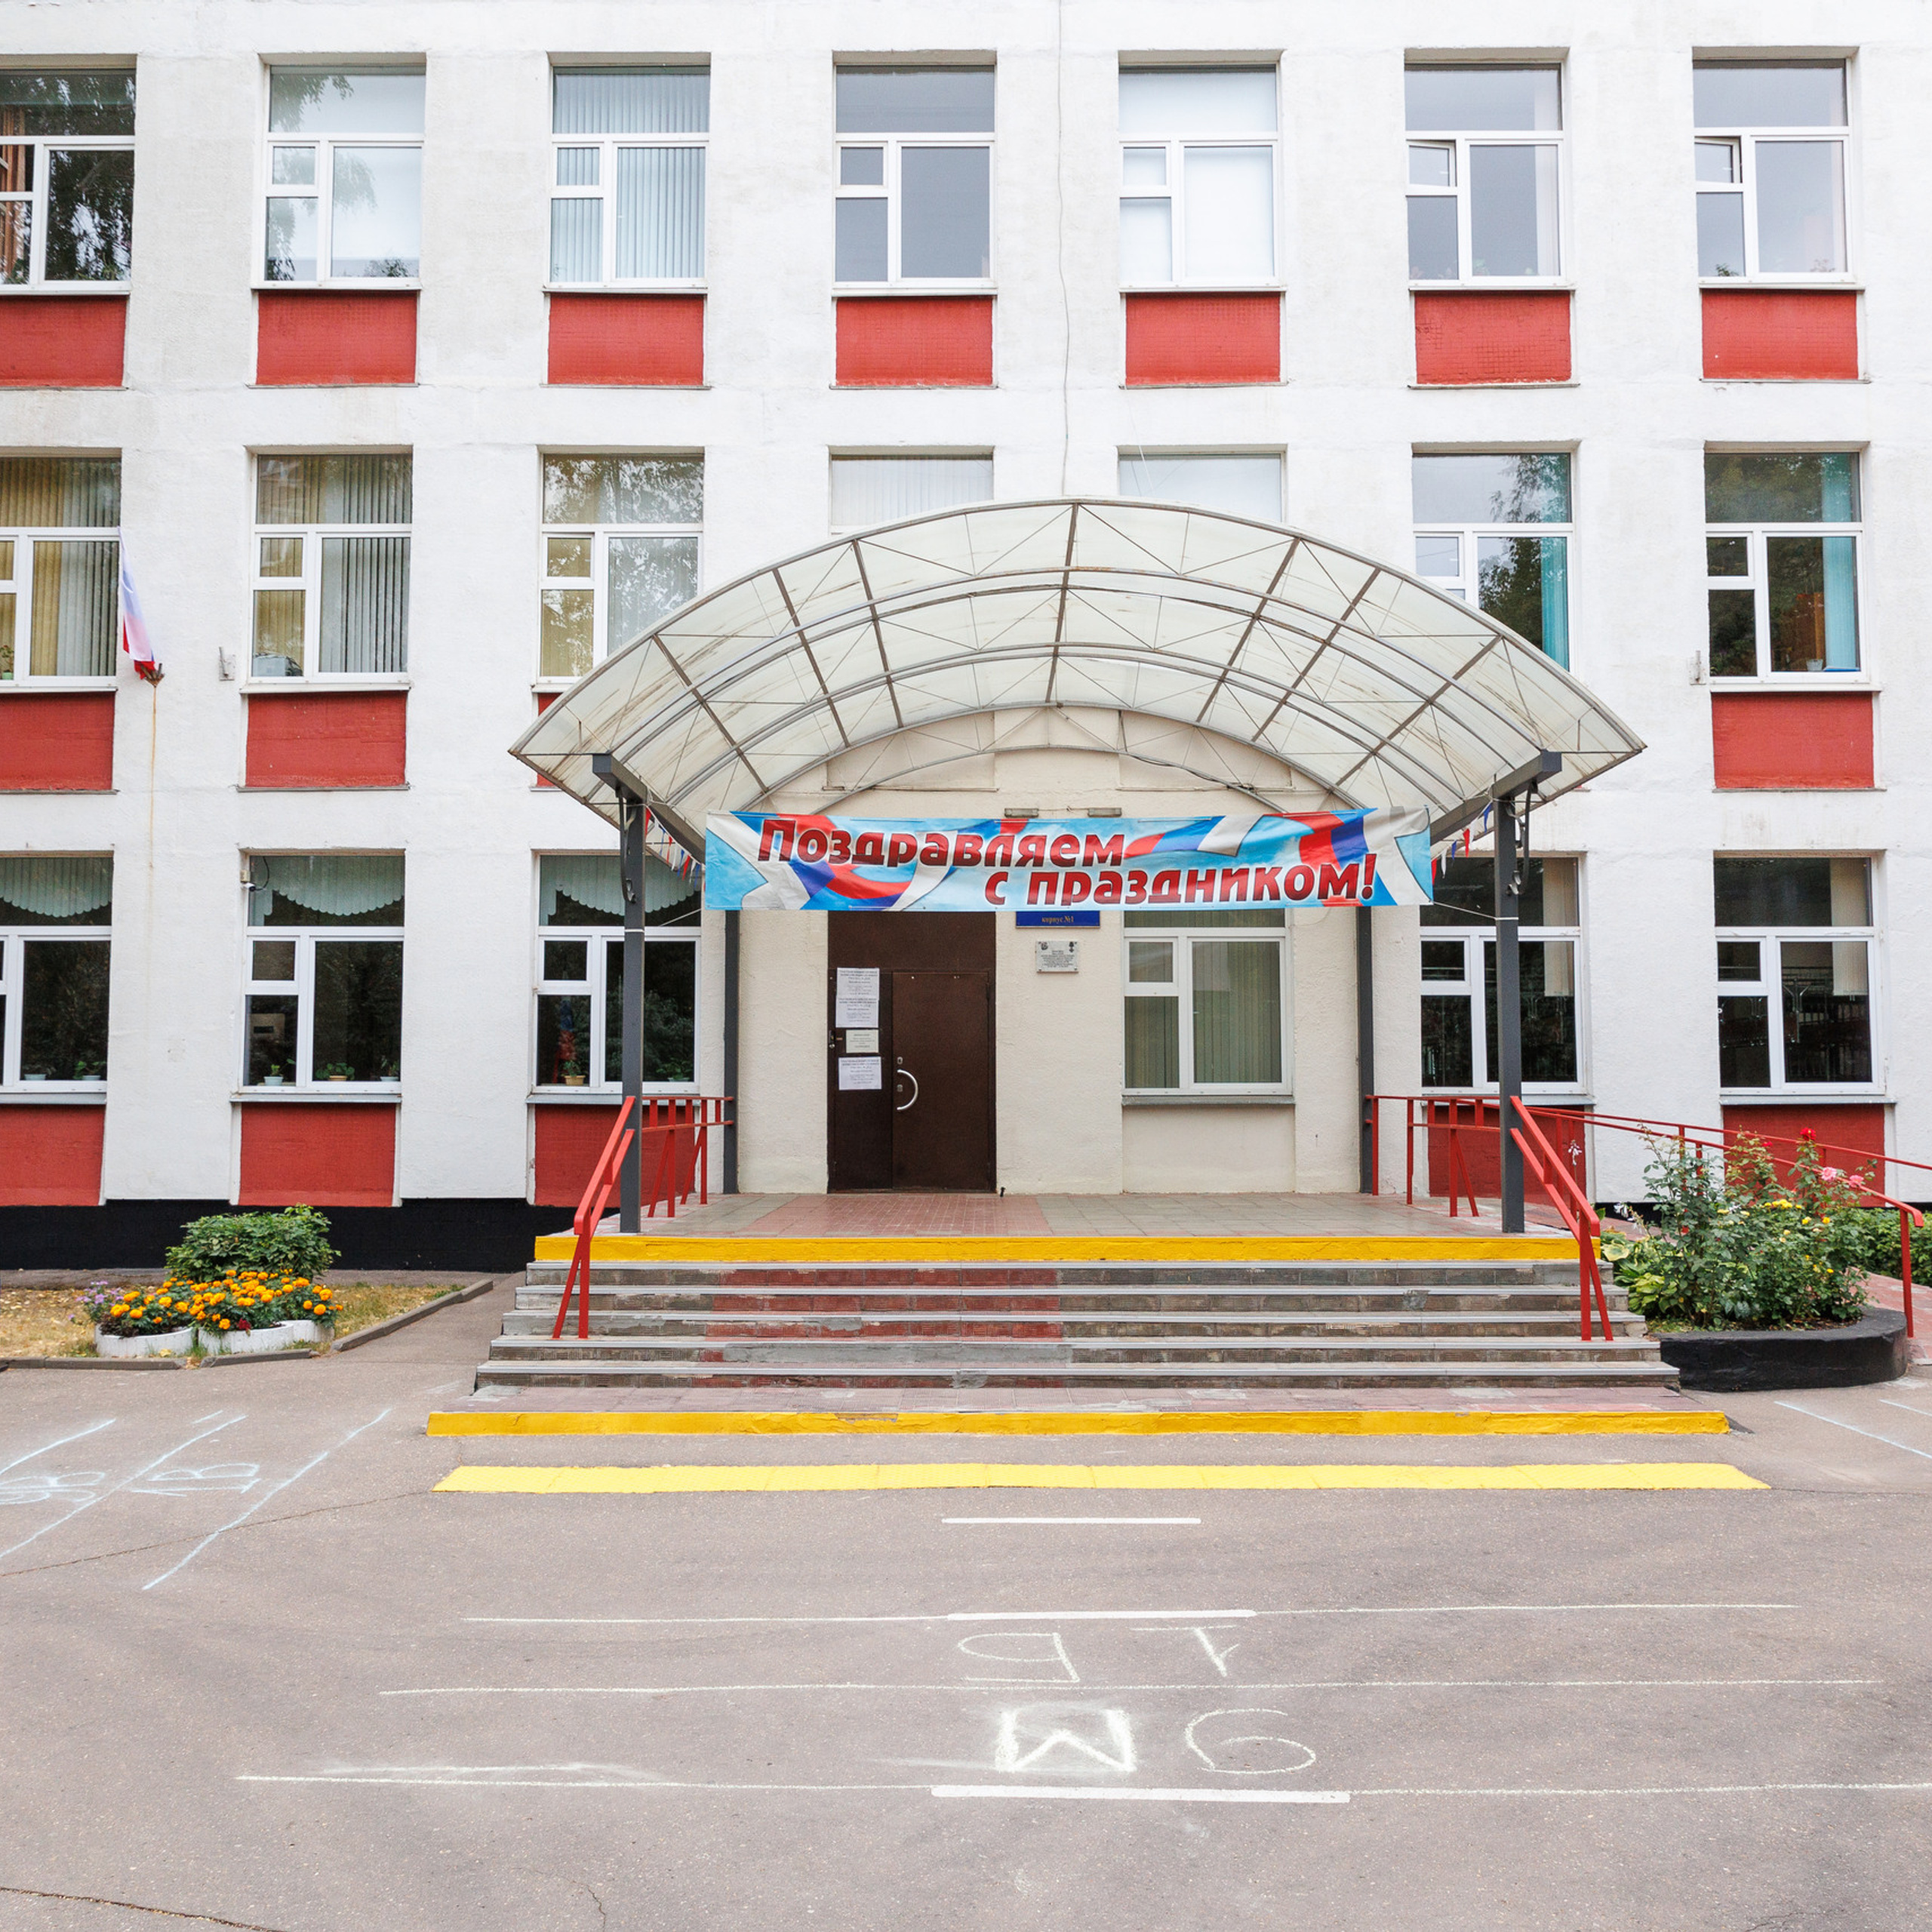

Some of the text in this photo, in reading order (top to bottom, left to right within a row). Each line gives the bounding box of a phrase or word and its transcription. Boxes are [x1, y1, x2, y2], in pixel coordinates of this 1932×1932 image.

[758, 819, 1124, 867] Поздравляем
[985, 854, 1377, 906] с праздником!
